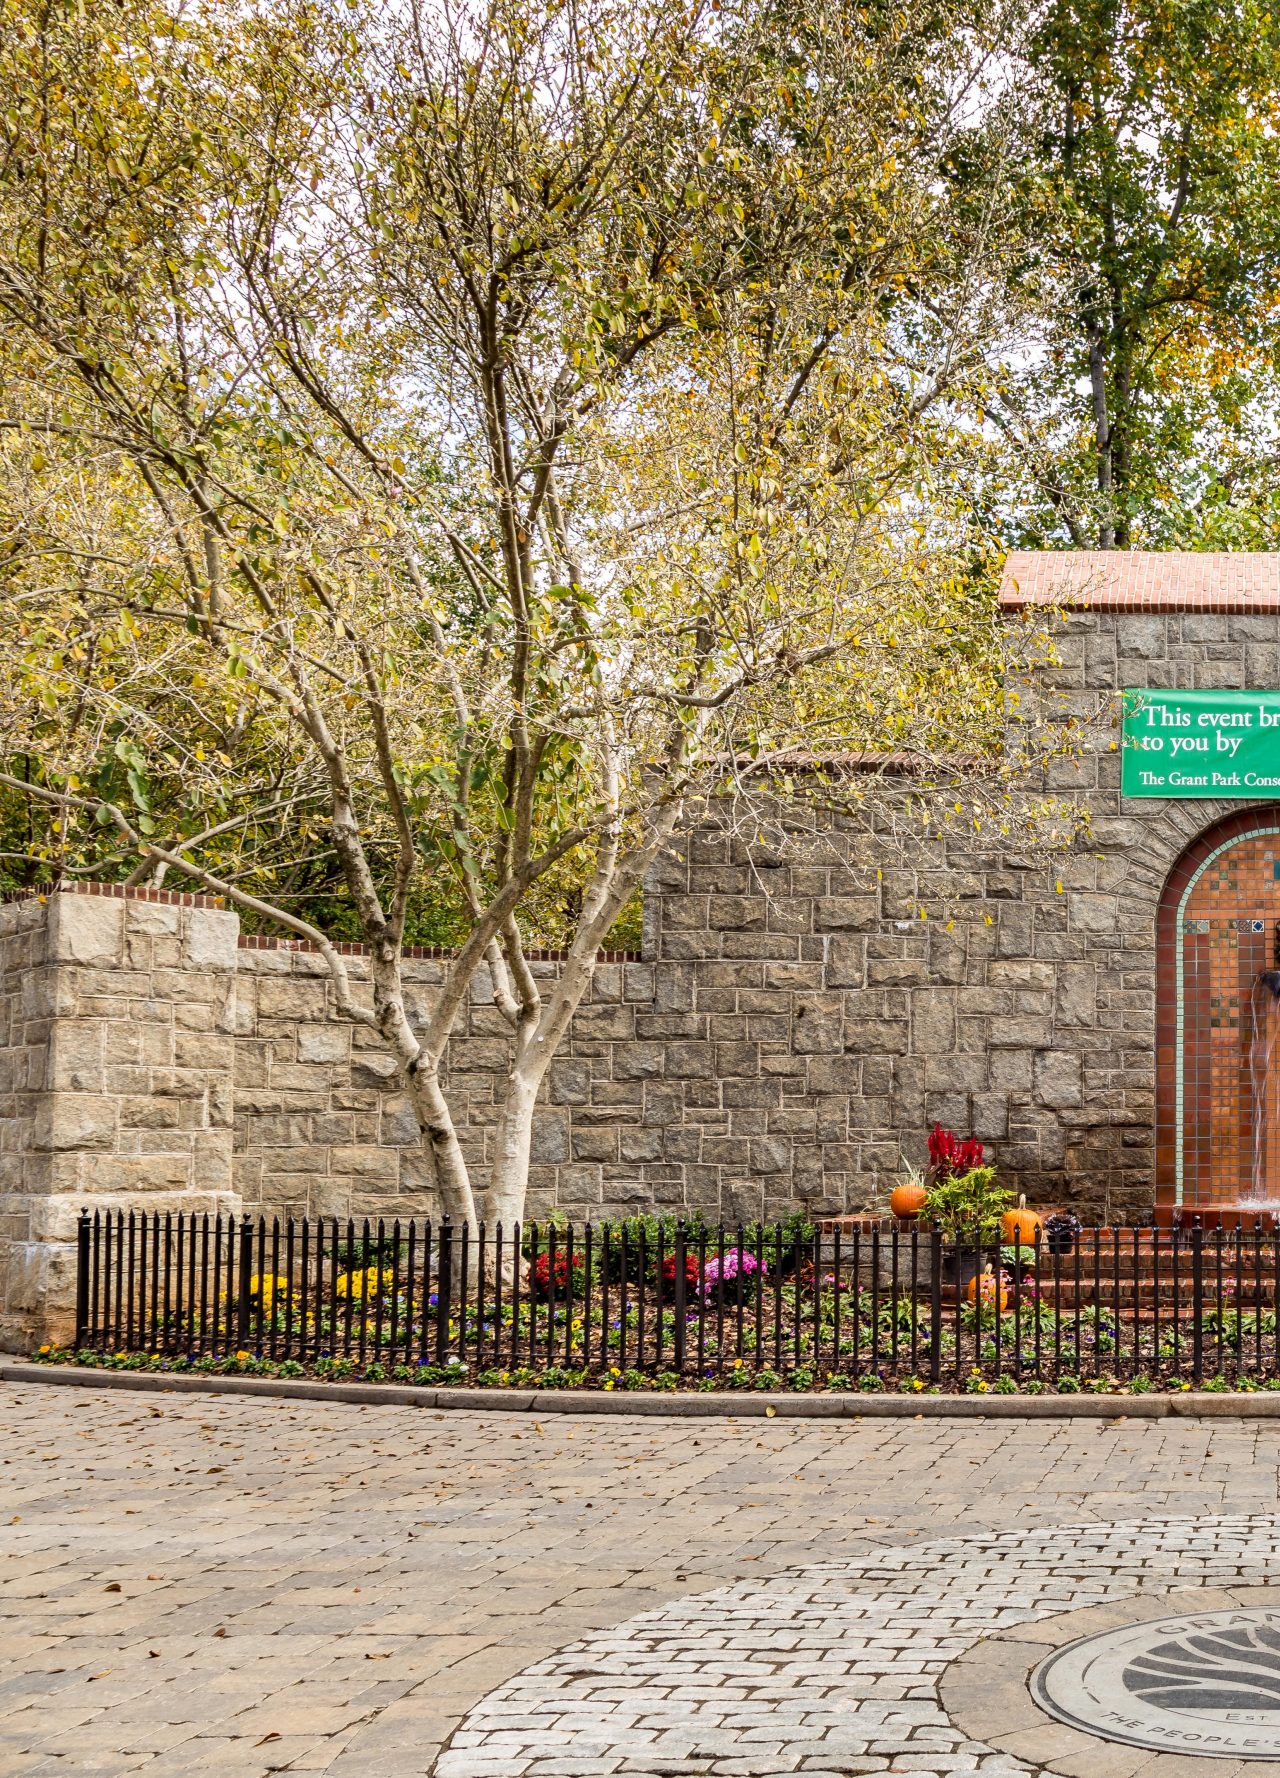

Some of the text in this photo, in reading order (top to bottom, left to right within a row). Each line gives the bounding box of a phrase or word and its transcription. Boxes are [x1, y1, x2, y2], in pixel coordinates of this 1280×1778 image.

[1142, 704, 1191, 727] This
[1197, 712, 1253, 727] event
[1141, 729, 1243, 758] to you by
[1138, 771, 1165, 785] The
[1168, 771, 1209, 786] Grant
[1211, 771, 1242, 786] Park
[1100, 1711, 1145, 1729] THE
